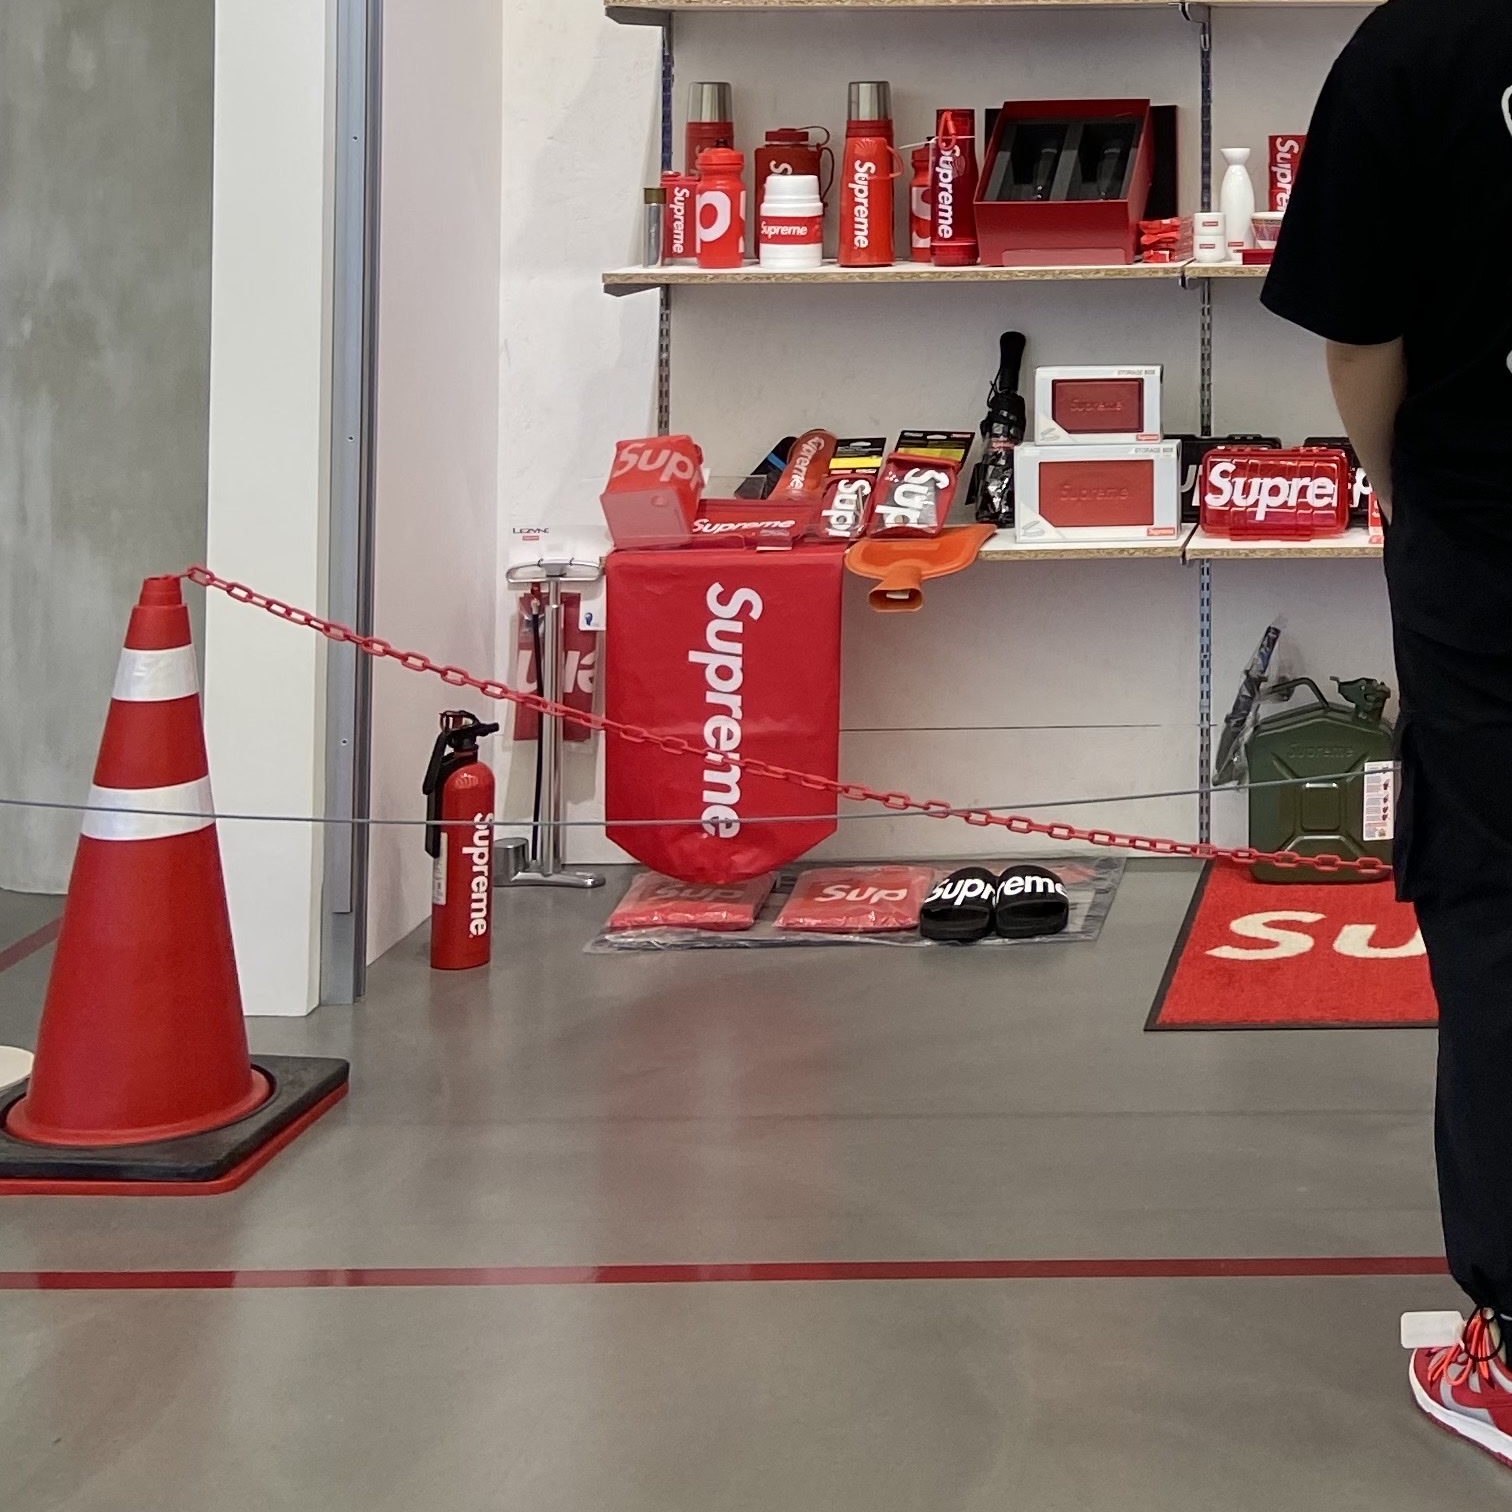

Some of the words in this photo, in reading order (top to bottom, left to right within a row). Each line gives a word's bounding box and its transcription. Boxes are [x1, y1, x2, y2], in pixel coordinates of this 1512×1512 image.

[669, 186, 690, 254] Supreme
[760, 220, 808, 238] Supreme
[848, 159, 876, 249] Supreme
[935, 144, 960, 239] Supreme
[691, 518, 796, 534] Supreme
[688, 582, 763, 838] Supreme
[462, 812, 494, 937] Supreme
